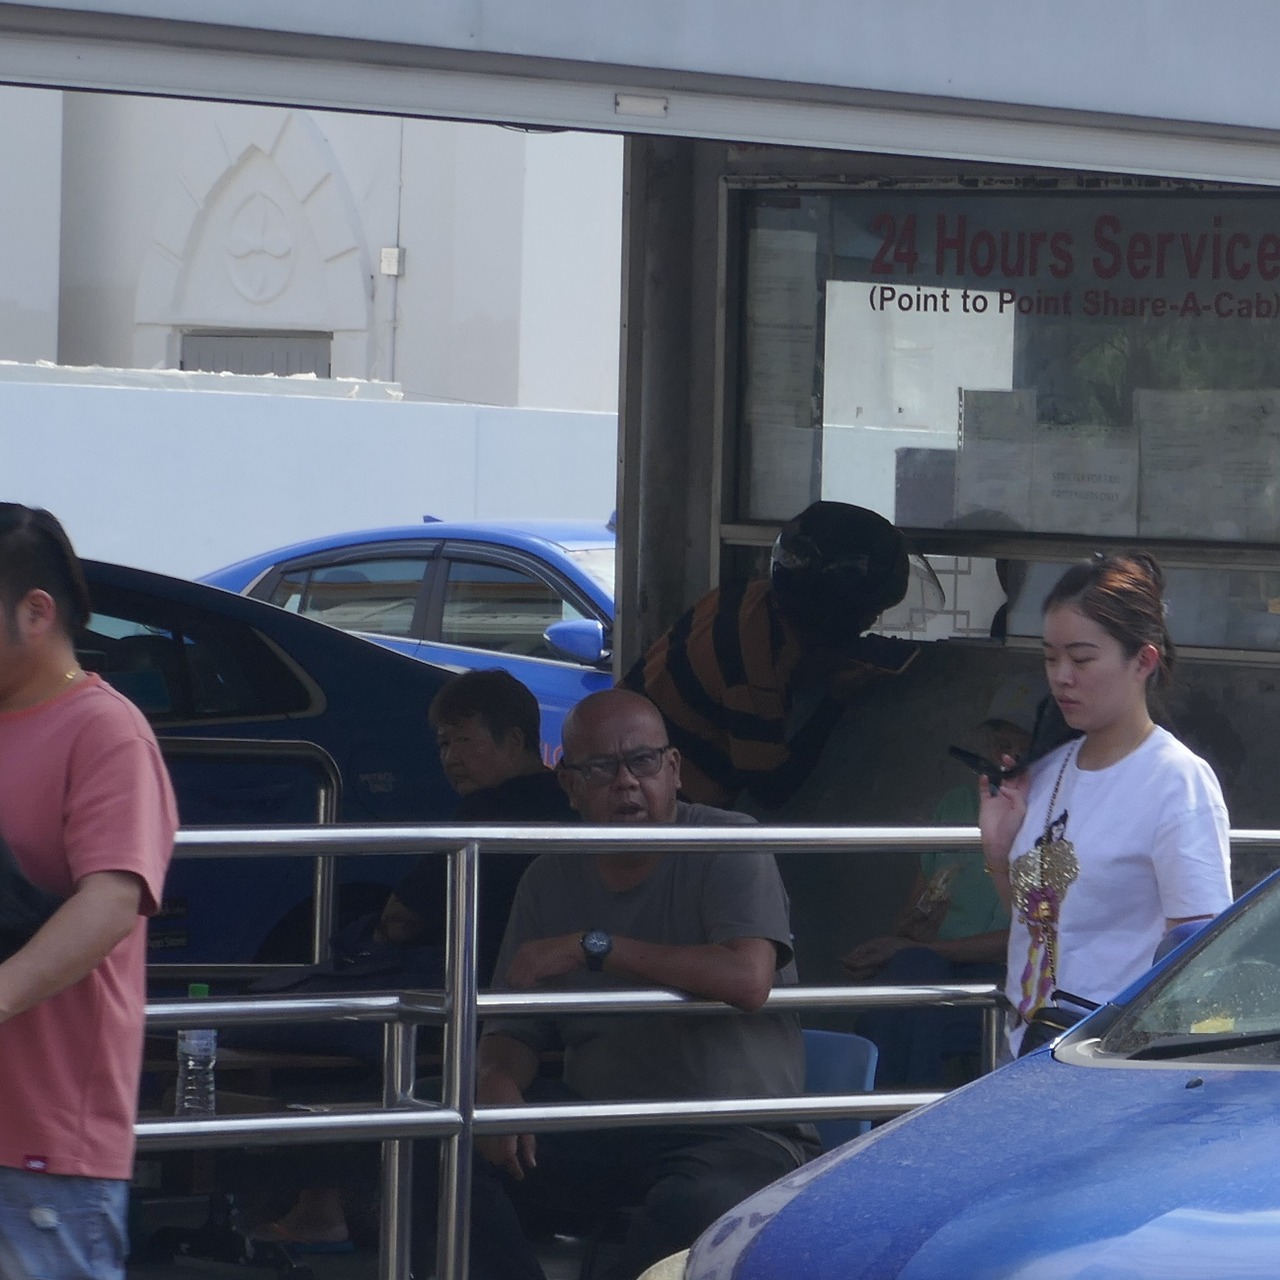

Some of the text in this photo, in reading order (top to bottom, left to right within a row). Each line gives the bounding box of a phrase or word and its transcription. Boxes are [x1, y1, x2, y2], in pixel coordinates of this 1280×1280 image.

[870, 213, 919, 275] 24
[935, 213, 1074, 279] Hours
[868, 285, 1280, 320] (Point to Point Share-A-Cab)
